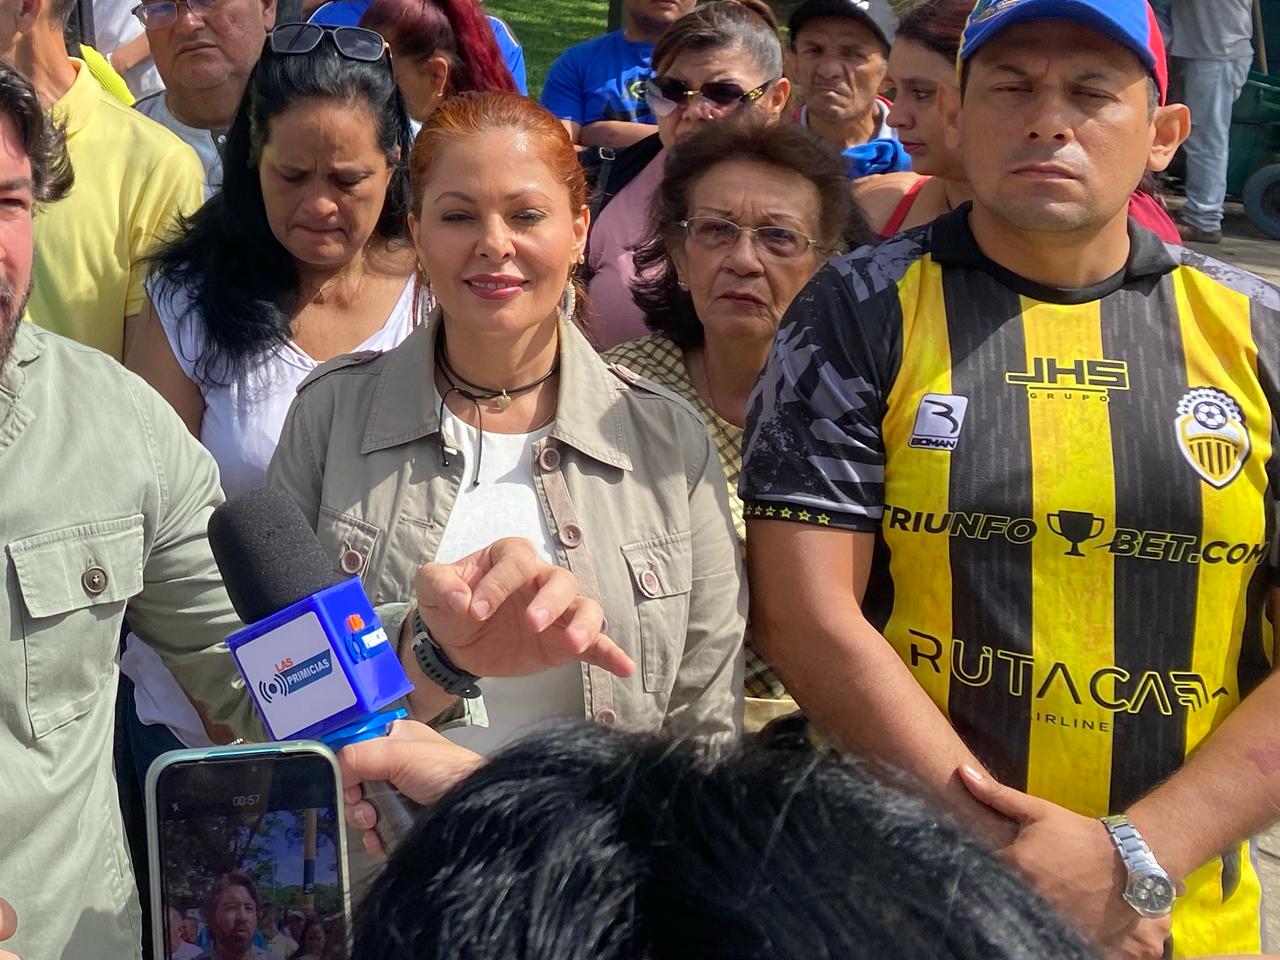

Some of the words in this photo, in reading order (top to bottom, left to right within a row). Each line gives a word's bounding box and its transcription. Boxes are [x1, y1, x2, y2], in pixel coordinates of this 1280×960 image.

[1006, 357, 1129, 390] JHS
[1029, 391, 1110, 402] GRUPO
[275, 657, 294, 673] LAS
[286, 657, 331, 687] PRIMICIAS
[232, 794, 261, 806] 00:57
